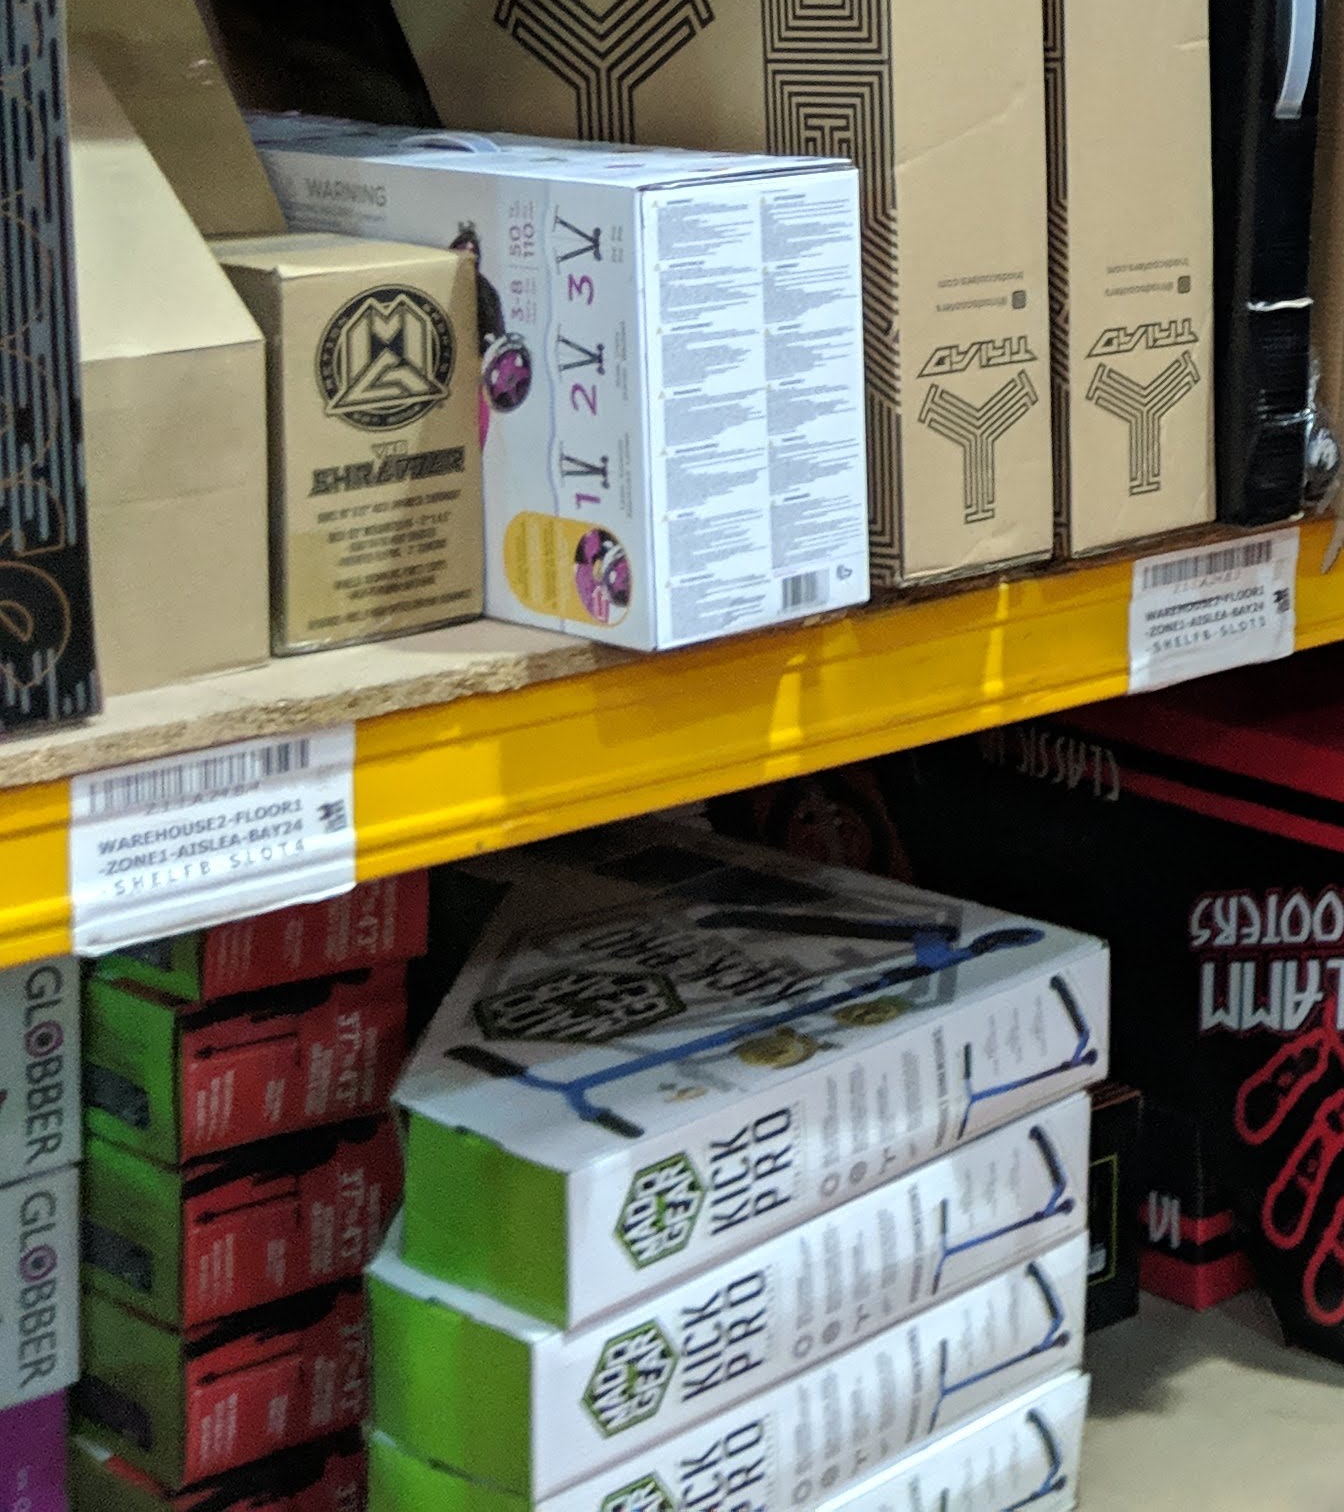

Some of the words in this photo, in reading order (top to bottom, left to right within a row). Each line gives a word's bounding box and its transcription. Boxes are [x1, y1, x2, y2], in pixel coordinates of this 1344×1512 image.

[305, 175, 386, 208] WARNING
[509, 225, 523, 257] 50
[522, 222, 535, 258] 110
[567, 273, 595, 306] 3
[918, 336, 1038, 379] TRIAD
[1087, 318, 1199, 359] TRIAD
[571, 382, 598, 416] 2
[99, 799, 303, 857] WAREHOUSE2-FLOOR1
[99, 817, 304, 878] -ZONE1-AISLEA-BAY24
[25, 965, 65, 1166] GLOBBER
[709, 1125, 754, 1236] KICK
[749, 1106, 794, 1222] PRO
[19, 1188, 58, 1389] GLOBBER
[681, 1287, 726, 1403] KICK
[724, 1268, 767, 1382] PRO
